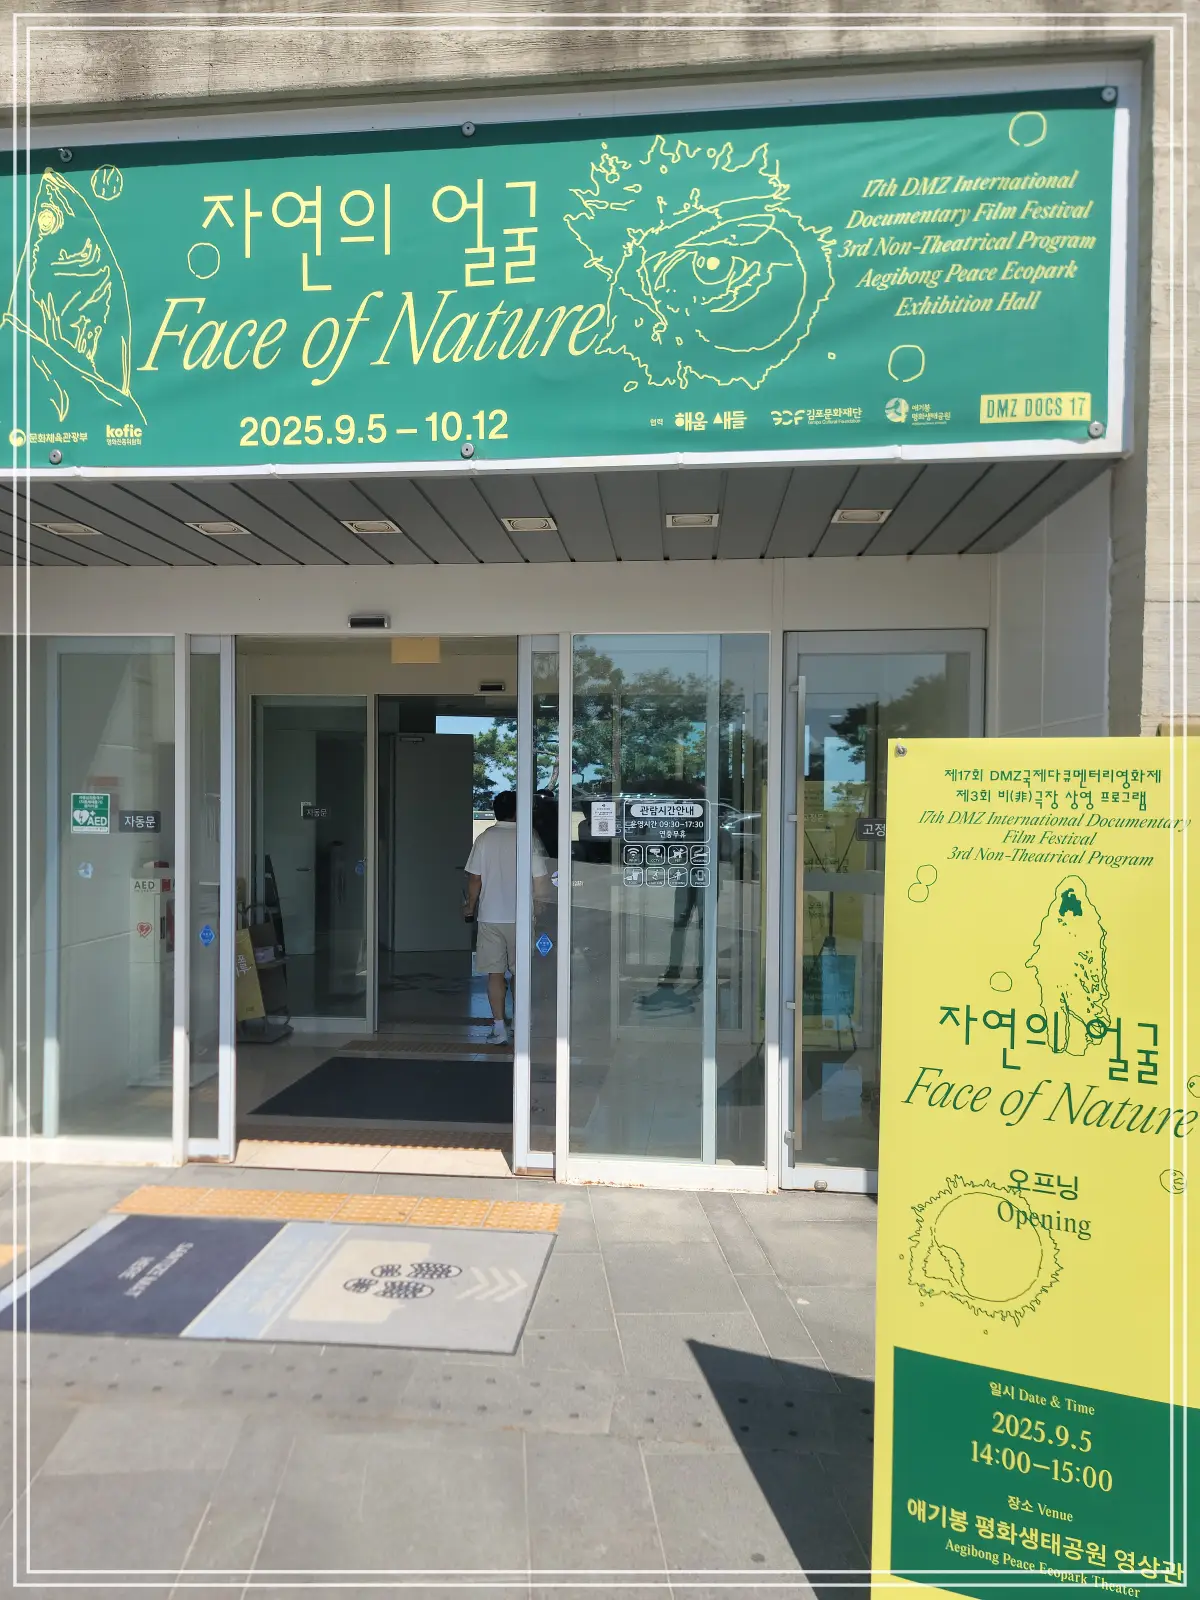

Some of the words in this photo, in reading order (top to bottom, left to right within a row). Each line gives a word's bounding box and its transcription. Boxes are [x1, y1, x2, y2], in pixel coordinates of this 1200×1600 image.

[861, 179, 898, 198] 17th
[900, 176, 952, 196] DMZ
[951, 170, 1079, 192] International
[845, 208, 970, 229] Documentary
[972, 202, 1017, 222] Film
[1020, 200, 1094, 220] Festival
[202, 184, 390, 291] 자연의
[432, 179, 538, 287] 얼굴
[837, 237, 873, 258] 3rd
[873, 231, 1017, 256] Non-Theatrical
[1017, 230, 1097, 253] Program
[855, 267, 944, 290] Aegibong
[944, 263, 998, 283] Peace
[999, 259, 1078, 284] Ecopark
[895, 294, 993, 316] Exhibition
[996, 290, 1042, 311] Hall
[137, 298, 287, 370] Face
[302, 291, 383, 386] of
[370, 290, 605, 365] Nature
[807, 407, 862, 421] 김포문화재단
[987, 399, 1017, 418] DMZ
[1025, 398, 1062, 416] DOCS
[1069, 397, 1086, 416] 17
[29, 432, 88, 443] 문화체육관광부
[106, 424, 142, 437] kofic
[239, 414, 388, 446] 2025.9.5
[425, 409, 508, 441] 10.12
[944, 768, 984, 783] 제17회
[990, 768, 1161, 789] DMZ국제다큐멘터리영화제
[639, 806, 694, 816] 관람시간안내
[956, 789, 991, 802] 제3회
[998, 789, 1059, 809] 비(非)극장
[1066, 790, 1094, 810] 상영
[1101, 791, 1147, 811] 프로그램
[87, 816, 107, 827] AED
[125, 816, 155, 828] 자동문
[631, 821, 657, 829] 운영시간
[659, 830, 686, 838] 연중무휴
[918, 810, 945, 824] 17th
[947, 811, 986, 824] DMZ
[985, 812, 1085, 827] International
[1086, 814, 1192, 832] Documentary
[1002, 830, 1036, 844] Film
[1037, 831, 1097, 846] Festival
[947, 847, 972, 861] 3rd
[974, 847, 1085, 864] Non-Theatrical
[1087, 851, 1154, 868] Program
[134, 881, 155, 890] AED
[939, 1005, 1059, 1070] 자연의
[1086, 1018, 1158, 1085] 얼굴
[901, 1066, 992, 1112] Face
[1000, 1079, 1051, 1126] of
[1044, 1082, 1199, 1138] Nature
[1007, 1168, 1079, 1200] 오프닝
[997, 1200, 1092, 1241] Opening
[989, 1382, 1015, 1400] 일시
[1019, 1388, 1047, 1406] Date
[1050, 1395, 1060, 1409] &
[1065, 1398, 1095, 1415] Time
[992, 1411, 1092, 1452] 2025.9.5
[1008, 1495, 1034, 1513] 장소
[1037, 1503, 1074, 1522] Venue
[907, 1498, 969, 1533] 애기봉
[975, 1514, 1107, 1567] 평화생태공원
[1114, 1548, 1184, 1585] 영상관
[945, 1539, 1000, 1565] Aegibong
[1003, 1553, 1036, 1572] Peace
[1040, 1561, 1087, 1586] Ecopark
[1091, 1574, 1140, 1598] Theater
